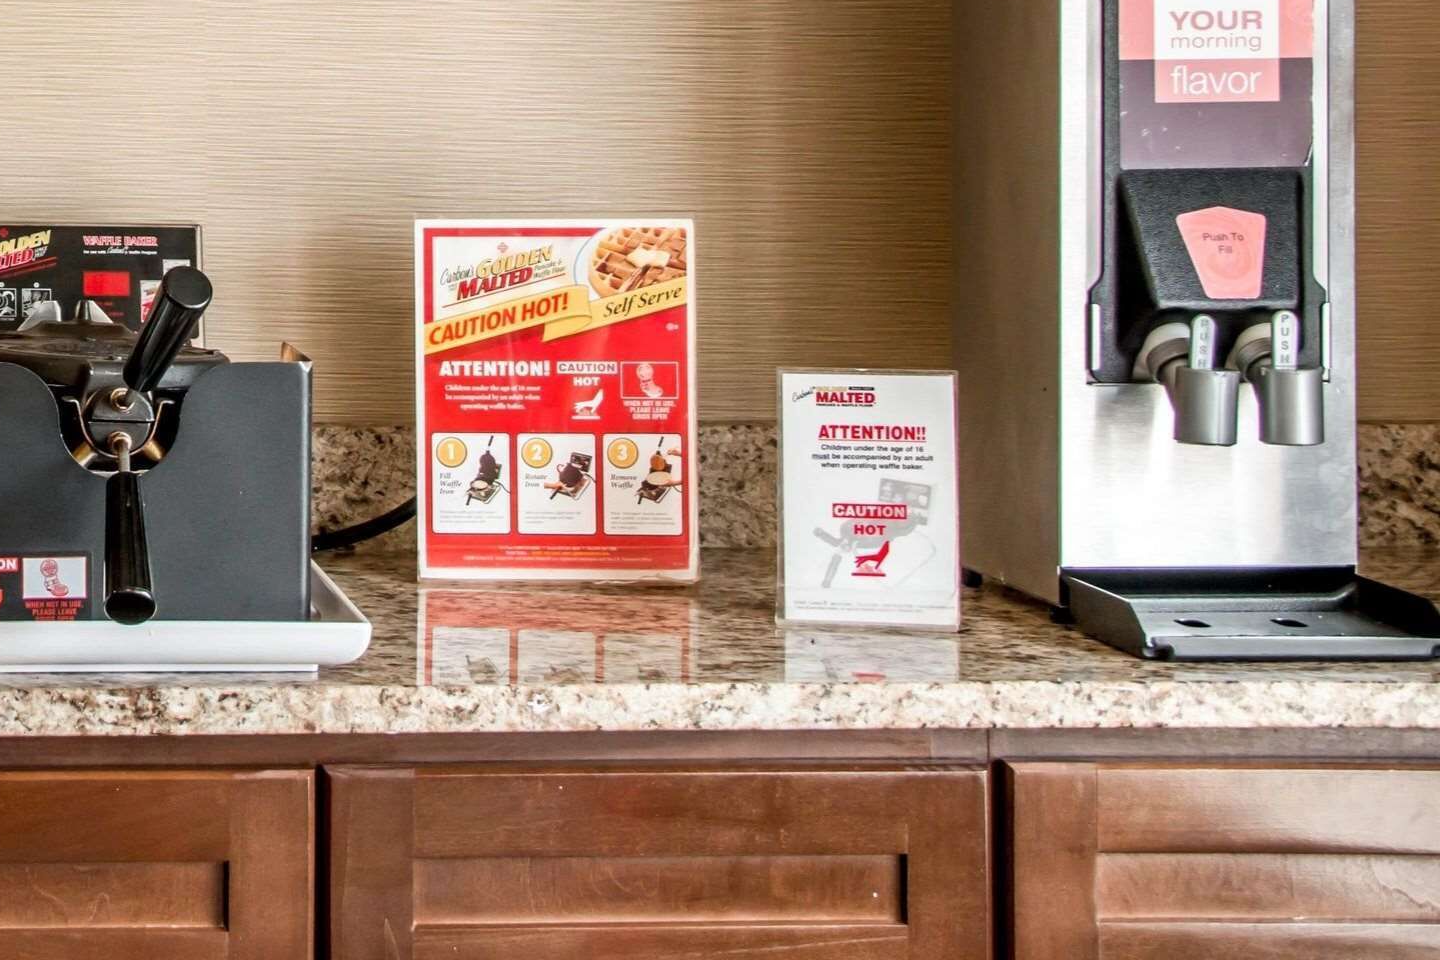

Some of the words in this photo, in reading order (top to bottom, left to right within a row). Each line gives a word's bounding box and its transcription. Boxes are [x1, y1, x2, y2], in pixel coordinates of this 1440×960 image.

[1168, 10, 1263, 30] YOUR
[1171, 32, 1262, 52] morning
[1170, 65, 1262, 95] flavor
[83, 235, 122, 246] WAFFLE
[124, 236, 158, 246] BAKER
[1203, 232, 1228, 241] Push
[1231, 232, 1244, 241] To
[1218, 245, 1233, 254] Fill
[476, 245, 552, 278] GOLDEN
[457, 267, 533, 300] MALTED
[603, 294, 637, 317] Self
[637, 287, 682, 308] Serve
[429, 306, 517, 345] CAUTION
[521, 292, 568, 321] HOT!
[1281, 314, 1290, 364] PUSH
[439, 360, 550, 377] ATTENTION!
[558, 363, 616, 372] CAUTION
[573, 377, 600, 386] HOT
[816, 392, 875, 403] MALTED
[819, 425, 926, 440] ATTENTION!!
[447, 445, 456, 460] 1
[532, 445, 543, 460] 2
[618, 445, 628, 460] 3
[843, 453, 891, 461] accompanied
[893, 454, 901, 462] by
[842, 462, 877, 470] operating
[440, 480, 462, 488] Waffle
[833, 506, 905, 518] CAUTION
[854, 524, 886, 535] HOT
